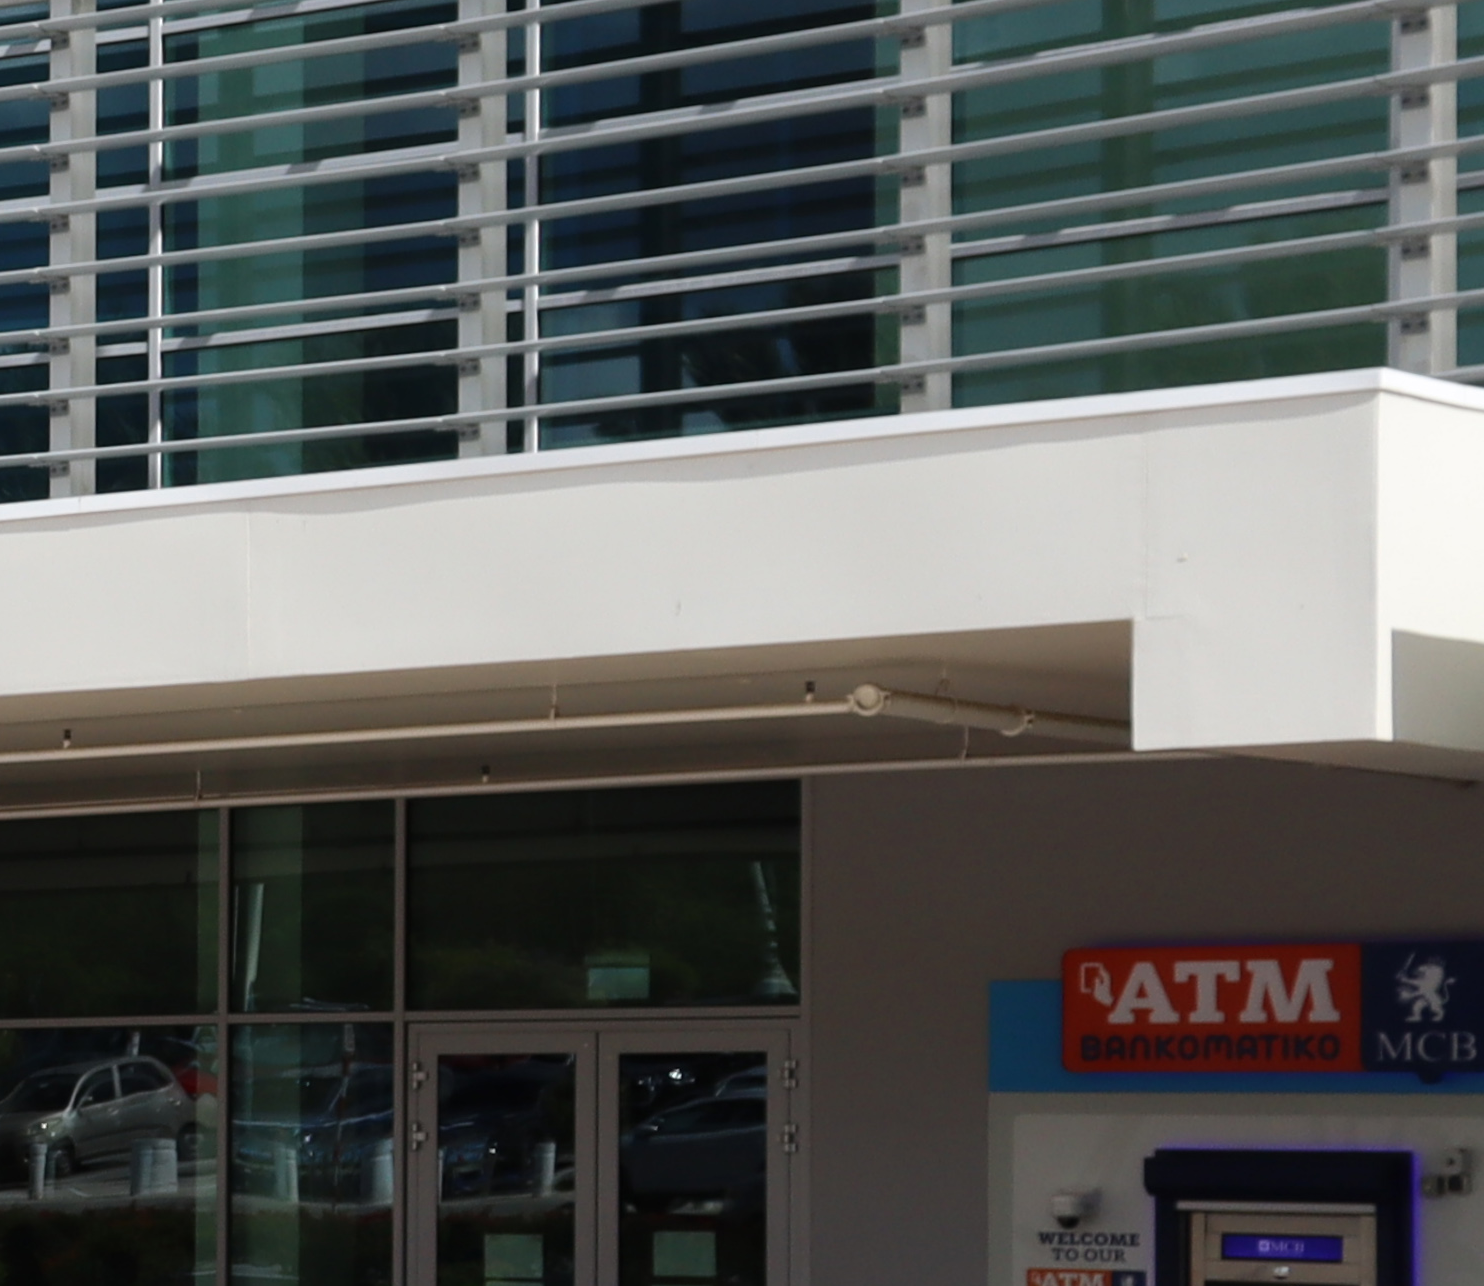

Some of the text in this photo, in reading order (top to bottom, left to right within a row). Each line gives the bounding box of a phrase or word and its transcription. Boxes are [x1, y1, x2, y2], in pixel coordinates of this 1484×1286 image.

[1107, 958, 1478, 1064] ATM MCB
[1080, 1033, 1341, 1062] BANKOMATIKO
[1039, 1231, 1141, 1247] WELCOME
[1051, 1247, 1126, 1262] TO OUR
